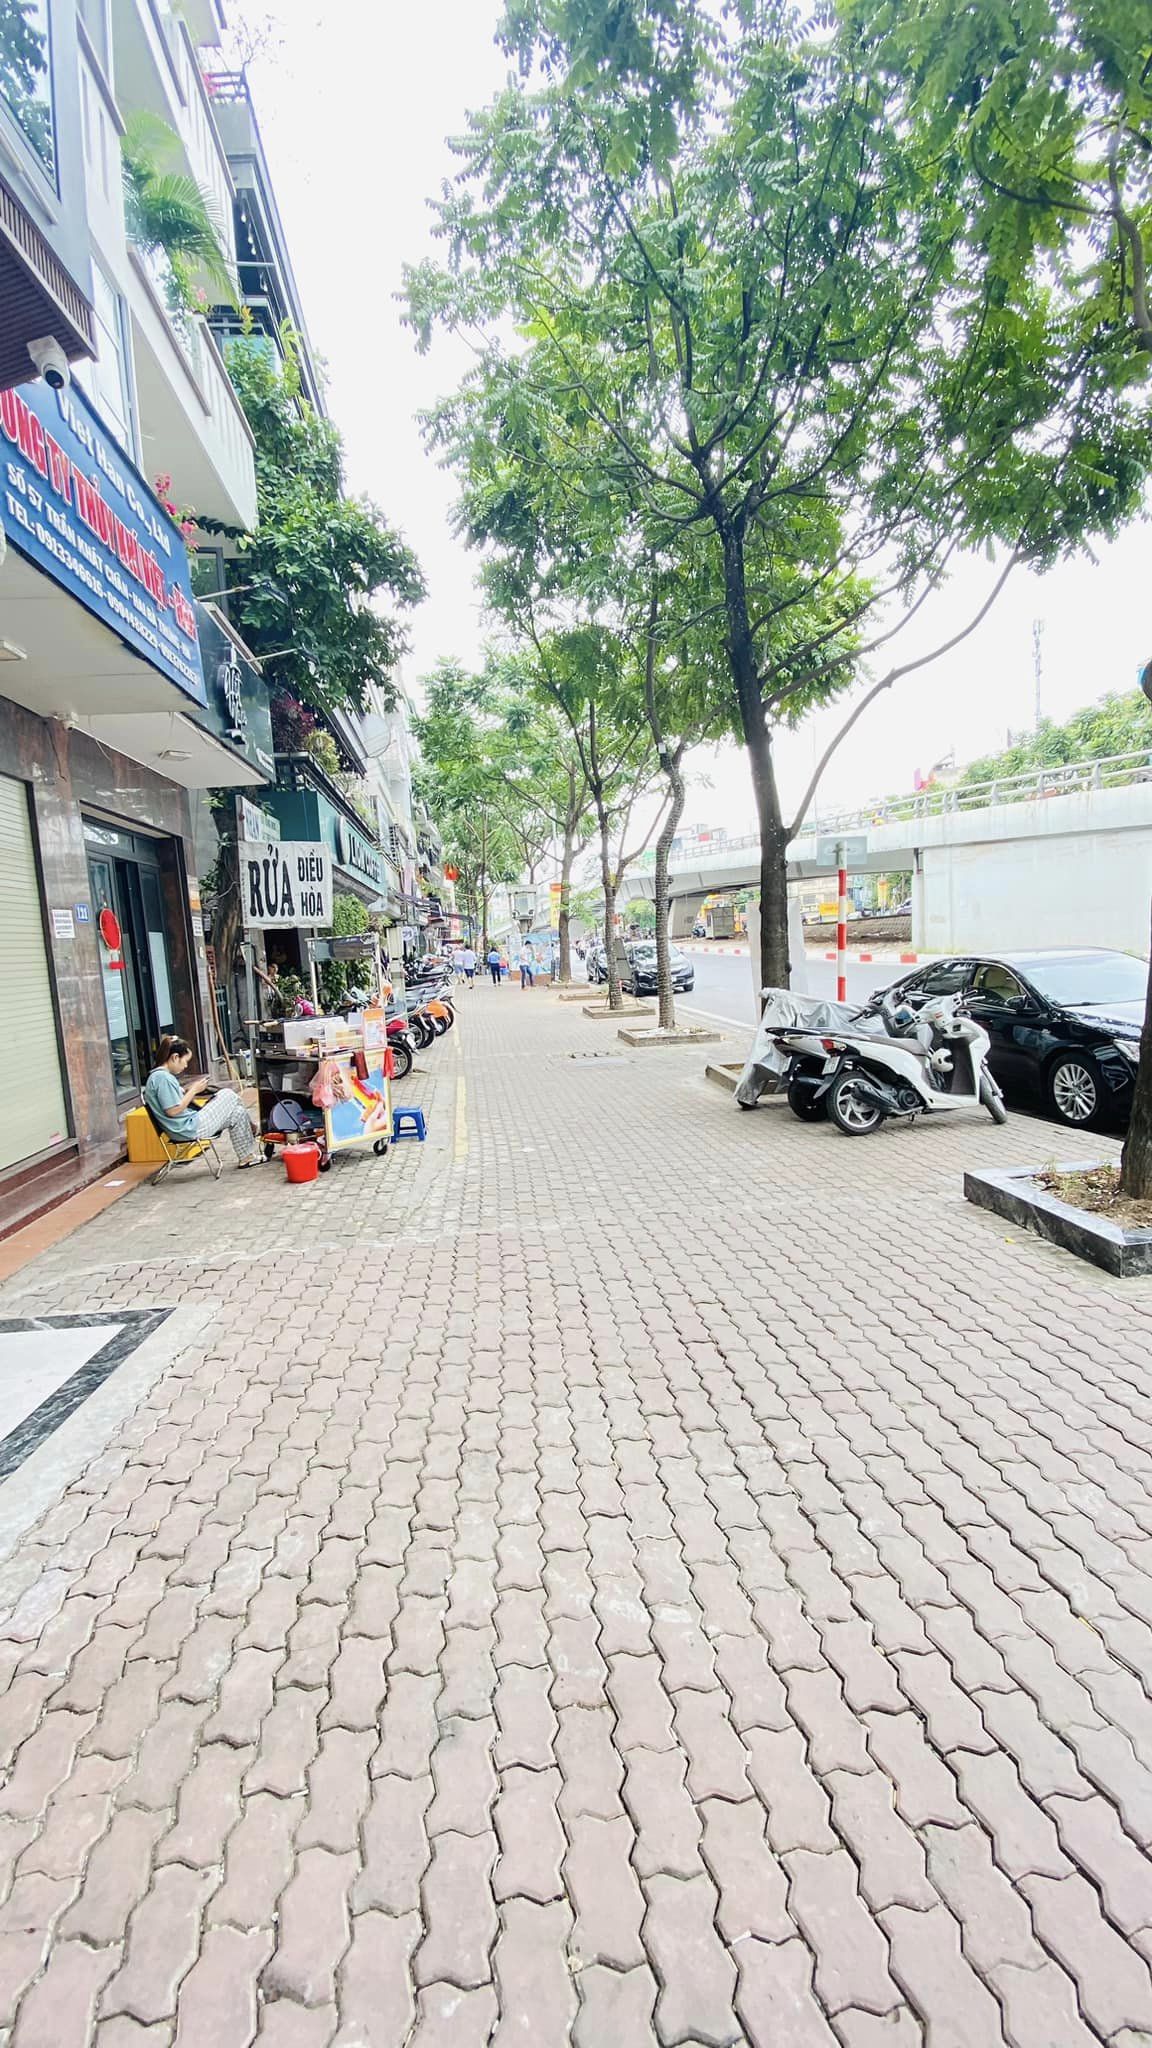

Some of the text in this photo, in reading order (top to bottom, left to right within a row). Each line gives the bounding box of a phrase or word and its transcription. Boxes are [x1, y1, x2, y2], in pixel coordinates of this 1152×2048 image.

[45, 427, 72, 507] TY
[95, 438, 125, 496] Han
[26, 484, 43, 512] 57
[248, 843, 295, 918] RỬA
[297, 848, 324, 882] ĐIỀU
[300, 885, 324, 917] HÒA
